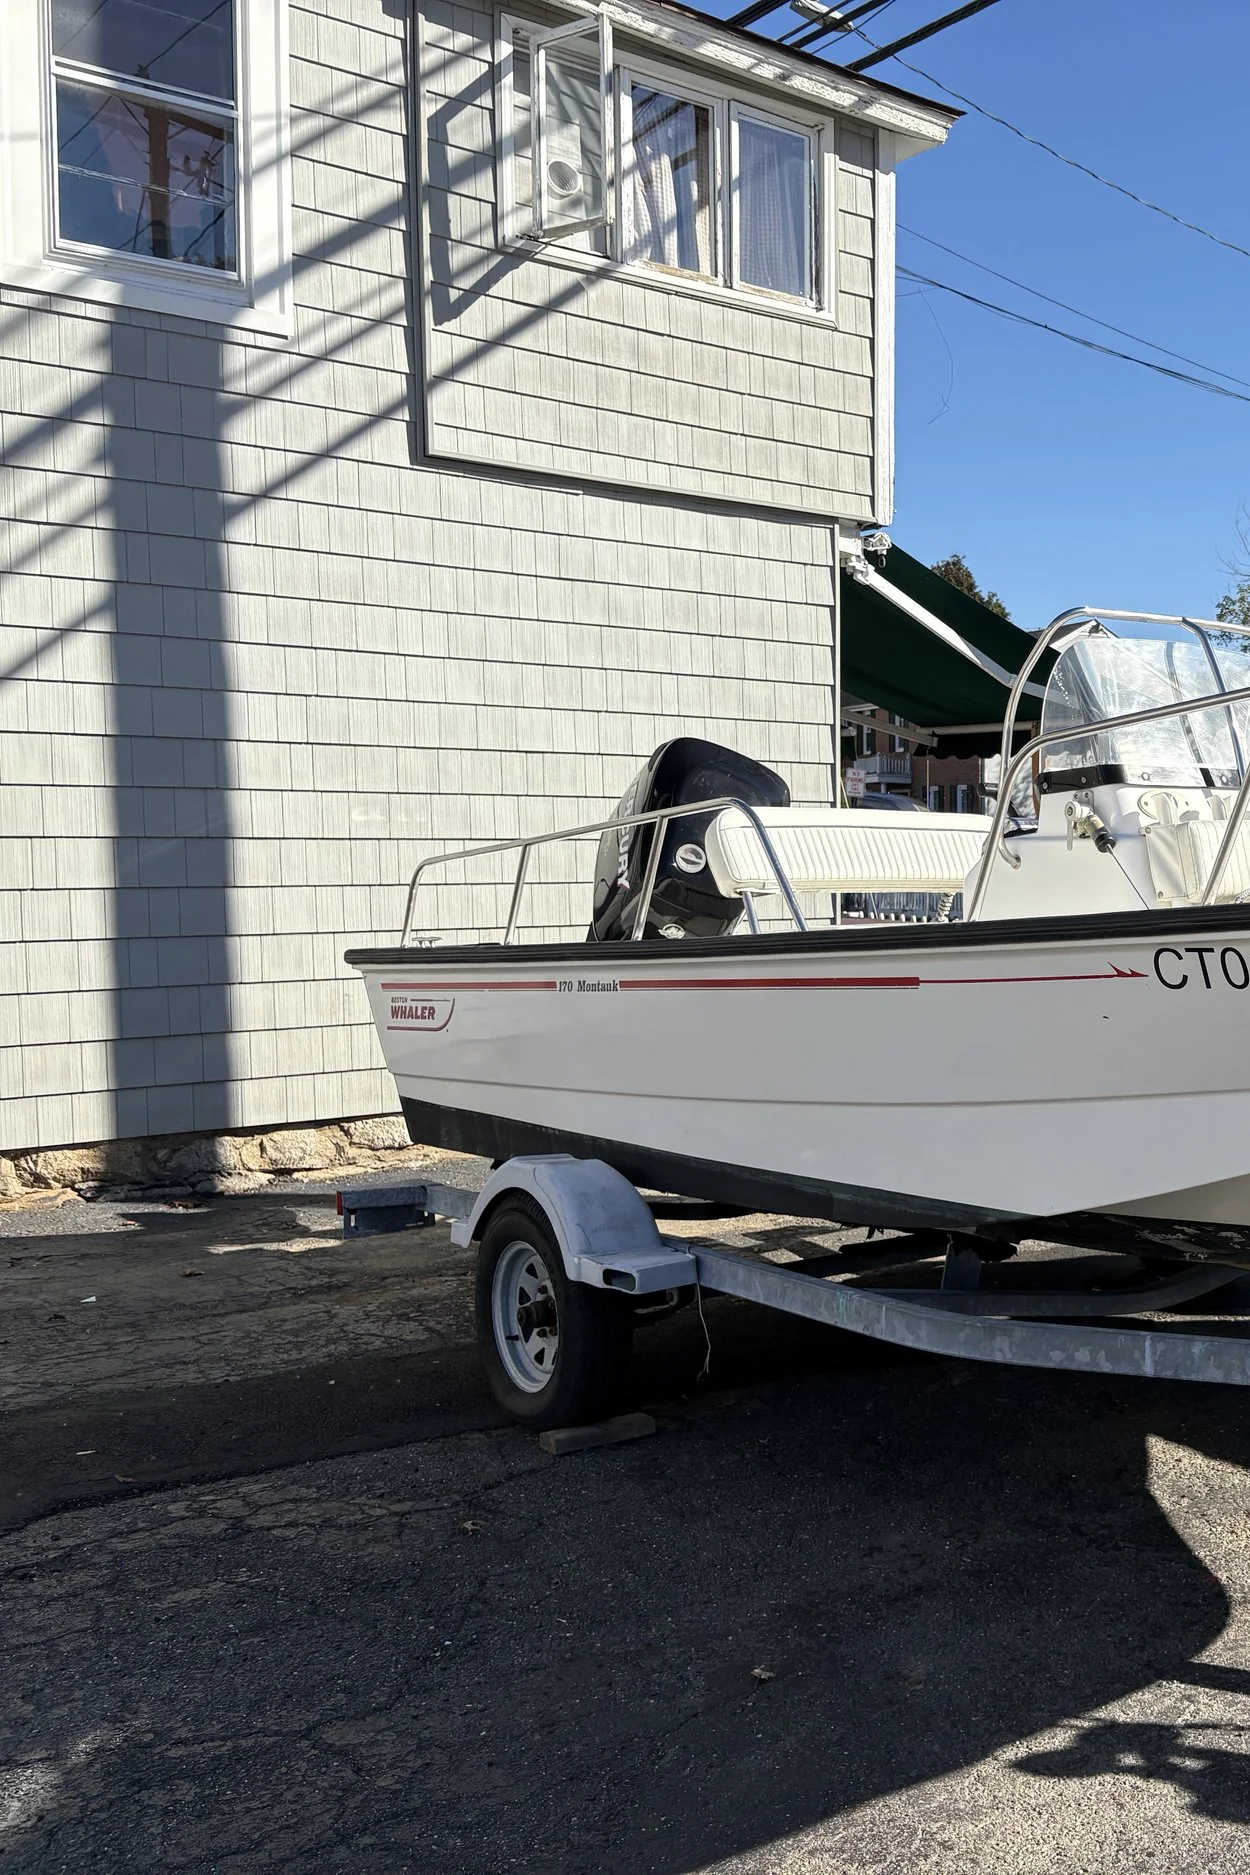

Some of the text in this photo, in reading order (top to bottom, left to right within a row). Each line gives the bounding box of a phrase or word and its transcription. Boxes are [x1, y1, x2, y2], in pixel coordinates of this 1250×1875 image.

[559, 979, 619, 993] 170 Montauk
[391, 1005, 436, 1020] WHALER
